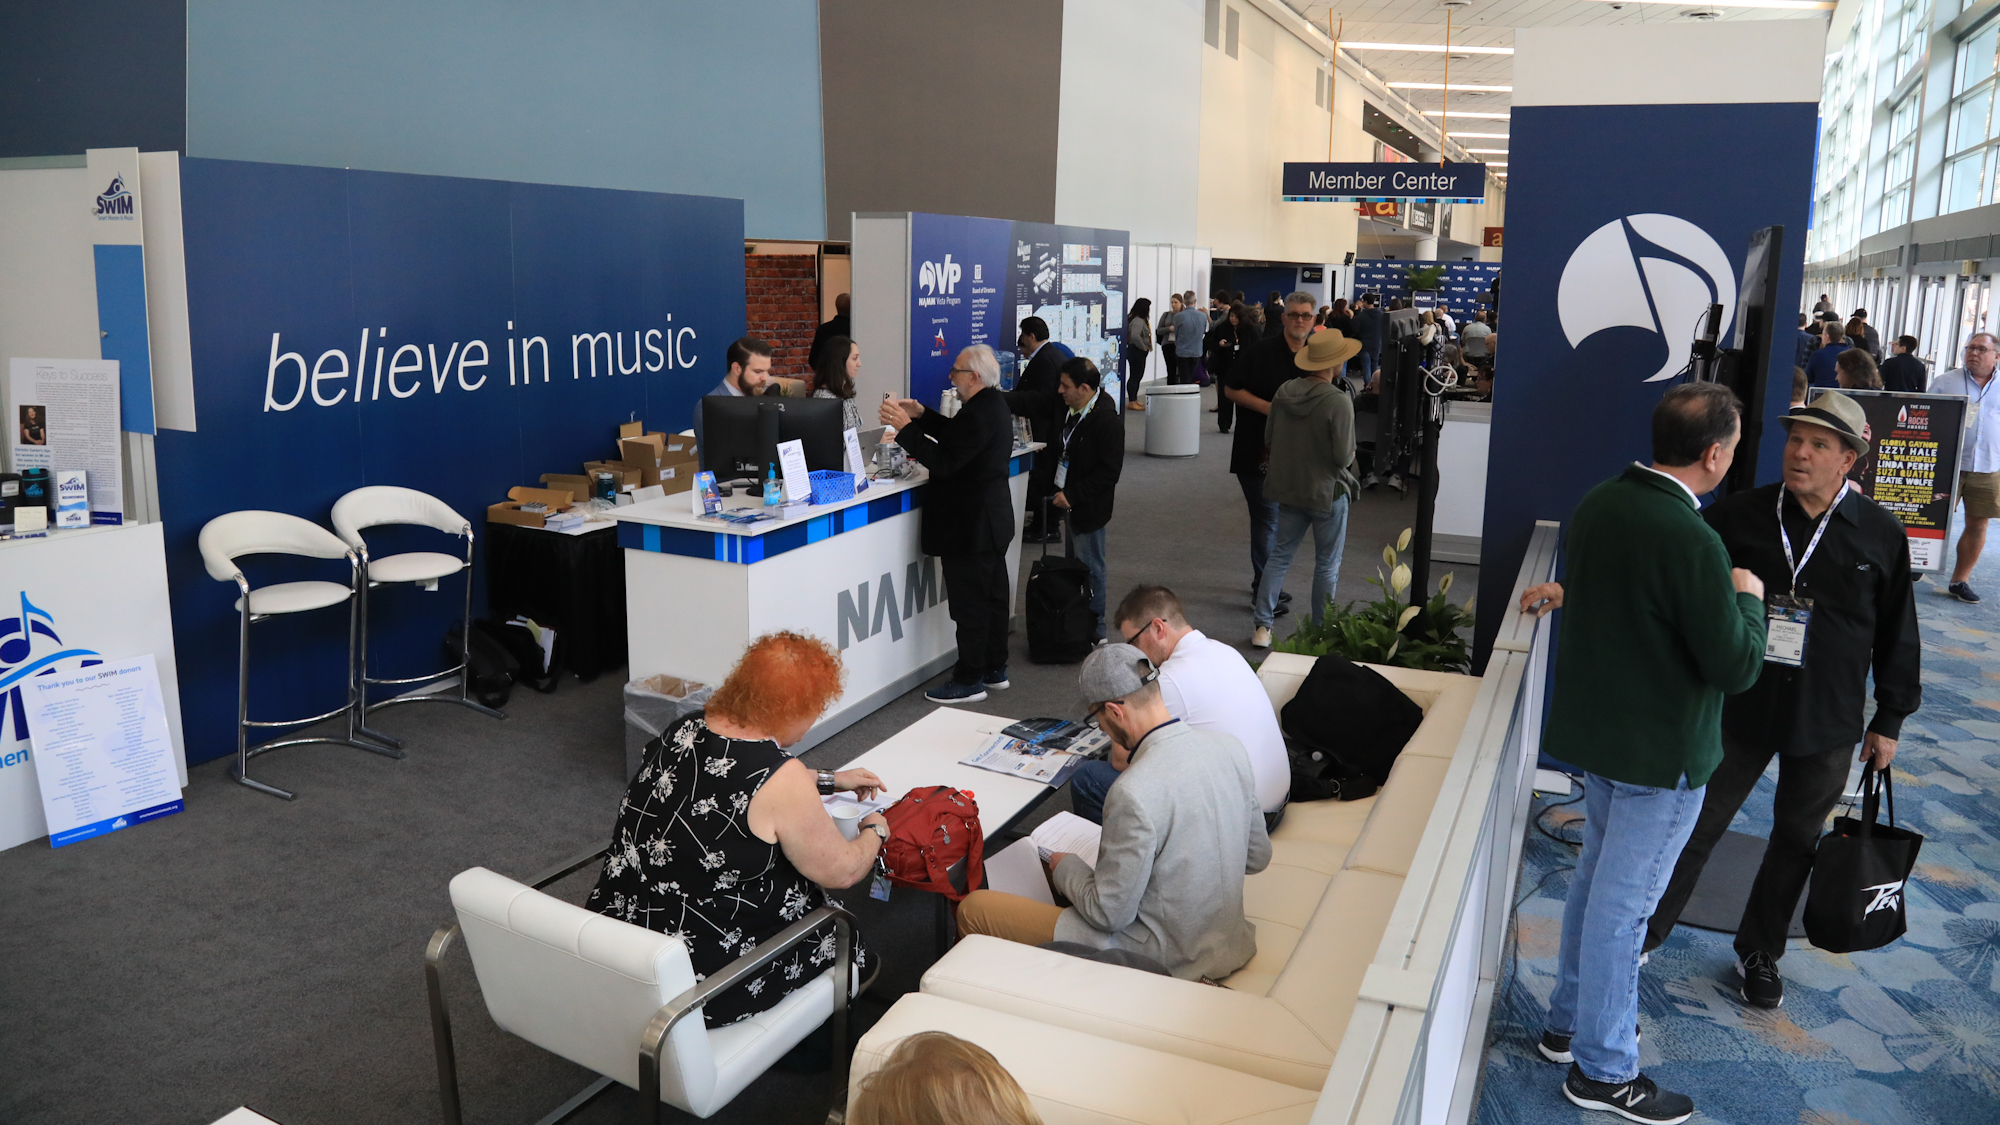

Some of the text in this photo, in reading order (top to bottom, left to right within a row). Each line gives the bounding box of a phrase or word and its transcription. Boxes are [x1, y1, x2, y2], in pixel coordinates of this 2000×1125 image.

[1309, 170, 1458, 191] Member Center
[97, 195, 133, 214] SWIM
[263, 313, 698, 413] believe in music
[36, 370, 108, 381] Keys to Success
[1907, 416, 1929, 426] ROCKS
[1880, 438, 1939, 449] GLORIA GAYNOR
[1879, 445, 1938, 457] LZZY HALE
[1878, 453, 1937, 463] TAL WILKENFELD
[1877, 460, 1936, 471] LINDA PERRY
[1876, 468, 1936, 479] SUZI QUATRO
[1875, 475, 1934, 487] BEATIE WOLFE
[60, 483, 85, 491] SWIM
[1873, 495, 1903, 503] OPENING:
[837, 556, 949, 651] NAM
[37, 681, 60, 692] Thank
[61, 679, 75, 688] you
[98, 669, 117, 680] SWIM
[118, 665, 142, 675] donors
